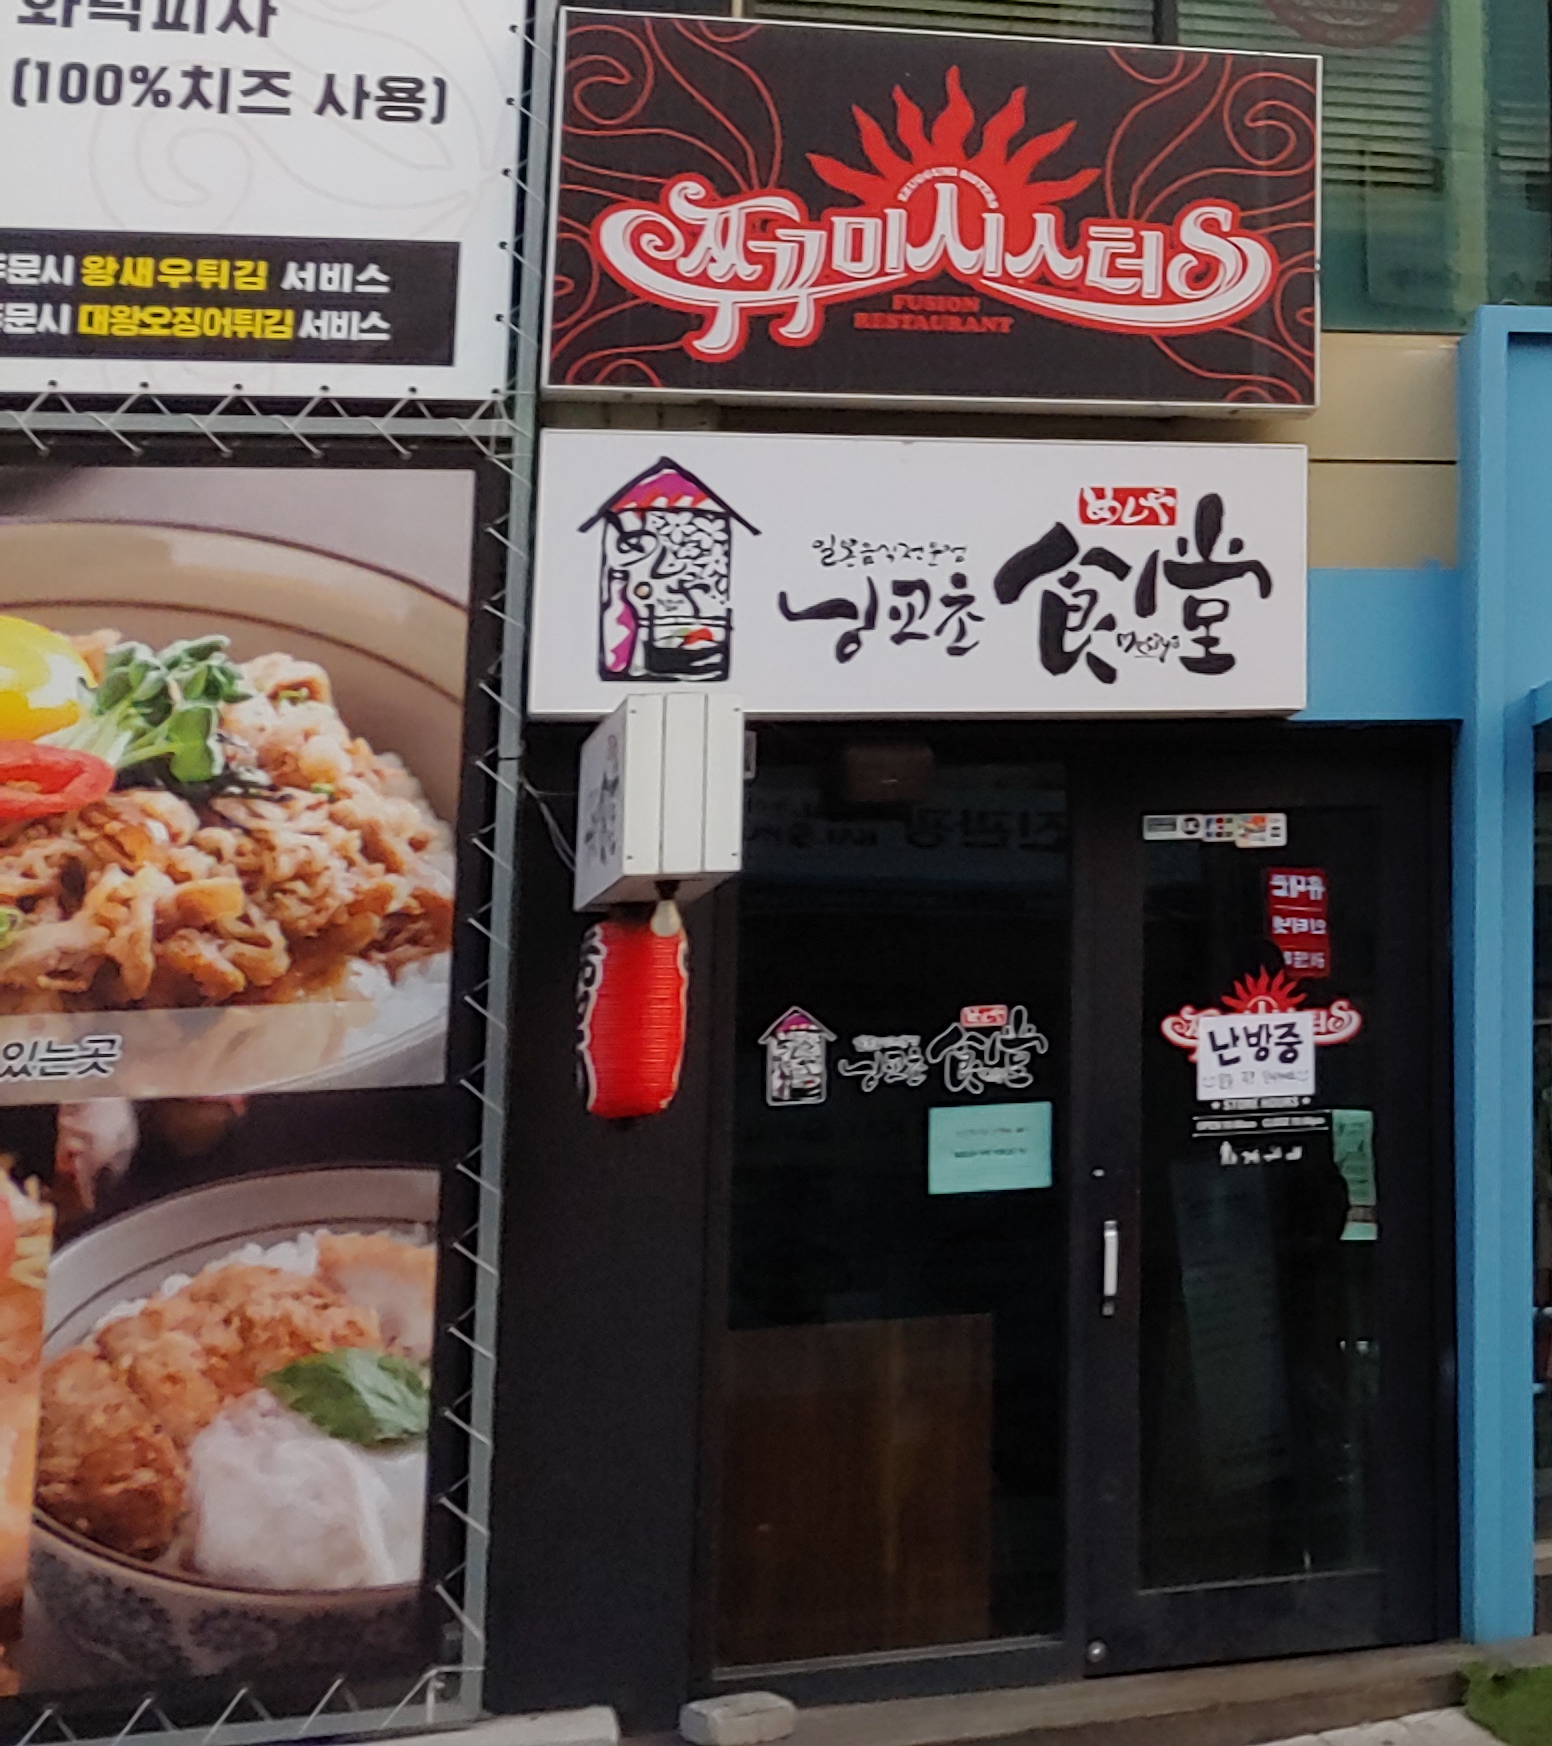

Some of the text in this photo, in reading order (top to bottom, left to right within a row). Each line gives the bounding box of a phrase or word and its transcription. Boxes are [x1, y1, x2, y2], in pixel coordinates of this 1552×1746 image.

[12, 57, 447, 125] (100%치즈 사용)
[80, 256, 269, 291] 왕새우튀김
[280, 260, 391, 293] 서비스
[299, 309, 391, 341] 서비스
[1208, 1022, 1303, 1066] 난방중
